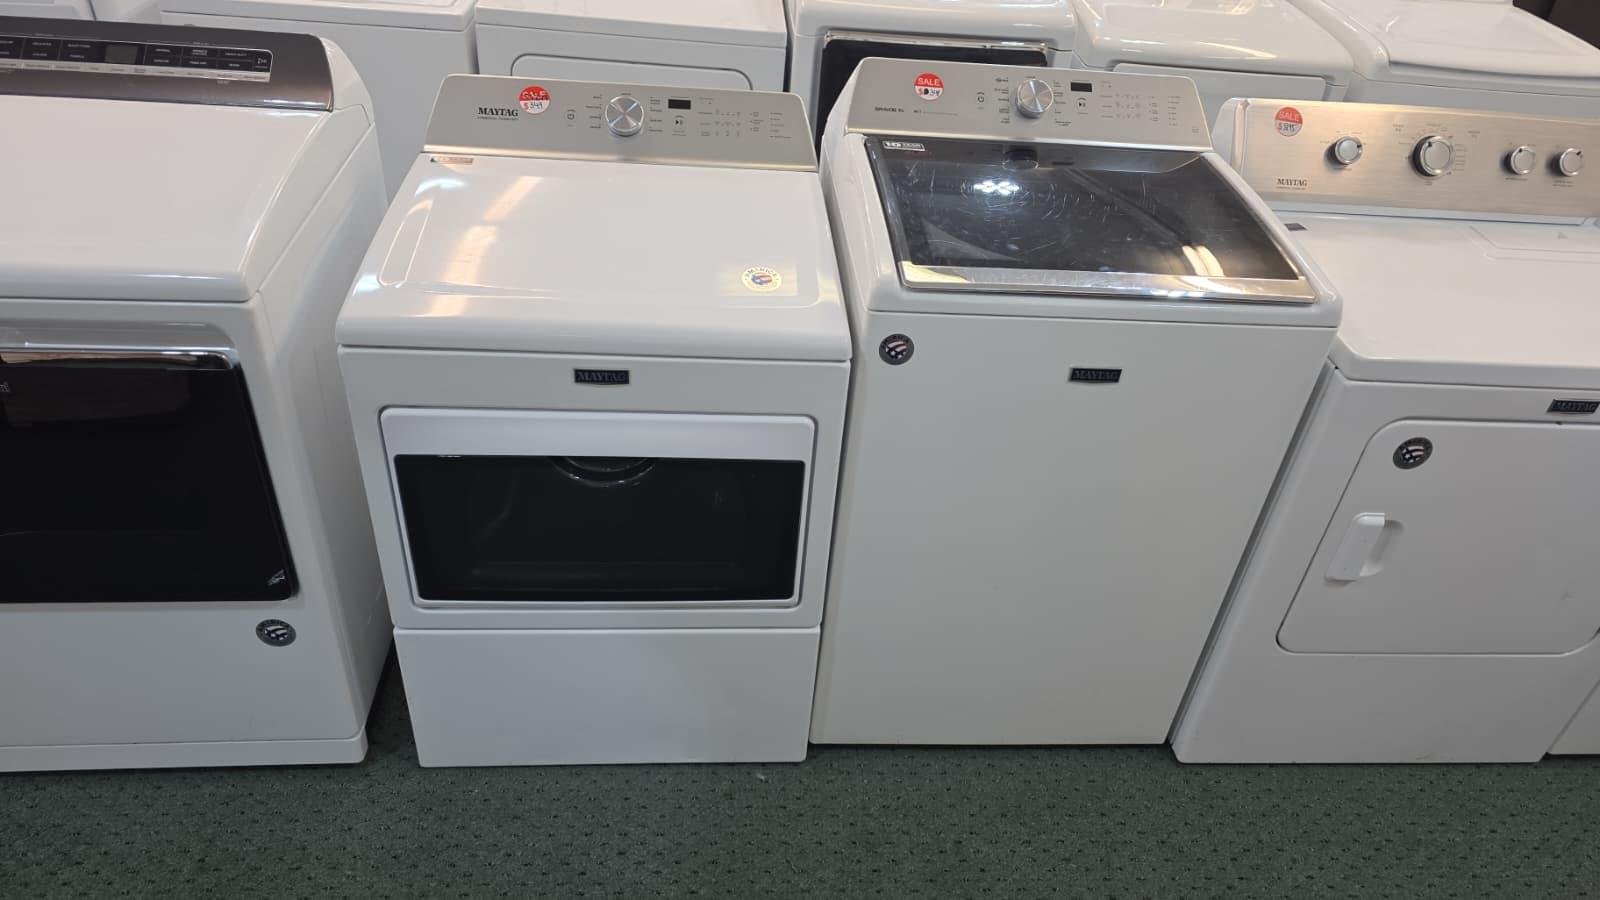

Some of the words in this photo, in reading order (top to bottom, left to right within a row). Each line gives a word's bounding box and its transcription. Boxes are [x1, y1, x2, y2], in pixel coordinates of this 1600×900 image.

[917, 77, 941, 87] SALE
[522, 90, 548, 100] SALE
[477, 106, 519, 117] MAYTAG
[1278, 110, 1300, 119] SALE
[1276, 178, 1308, 187] MAYTAG
[576, 370, 627, 382] MAYTAG
[1073, 370, 1119, 380] MAYTAG
[1553, 402, 1596, 411] MAYTAG
